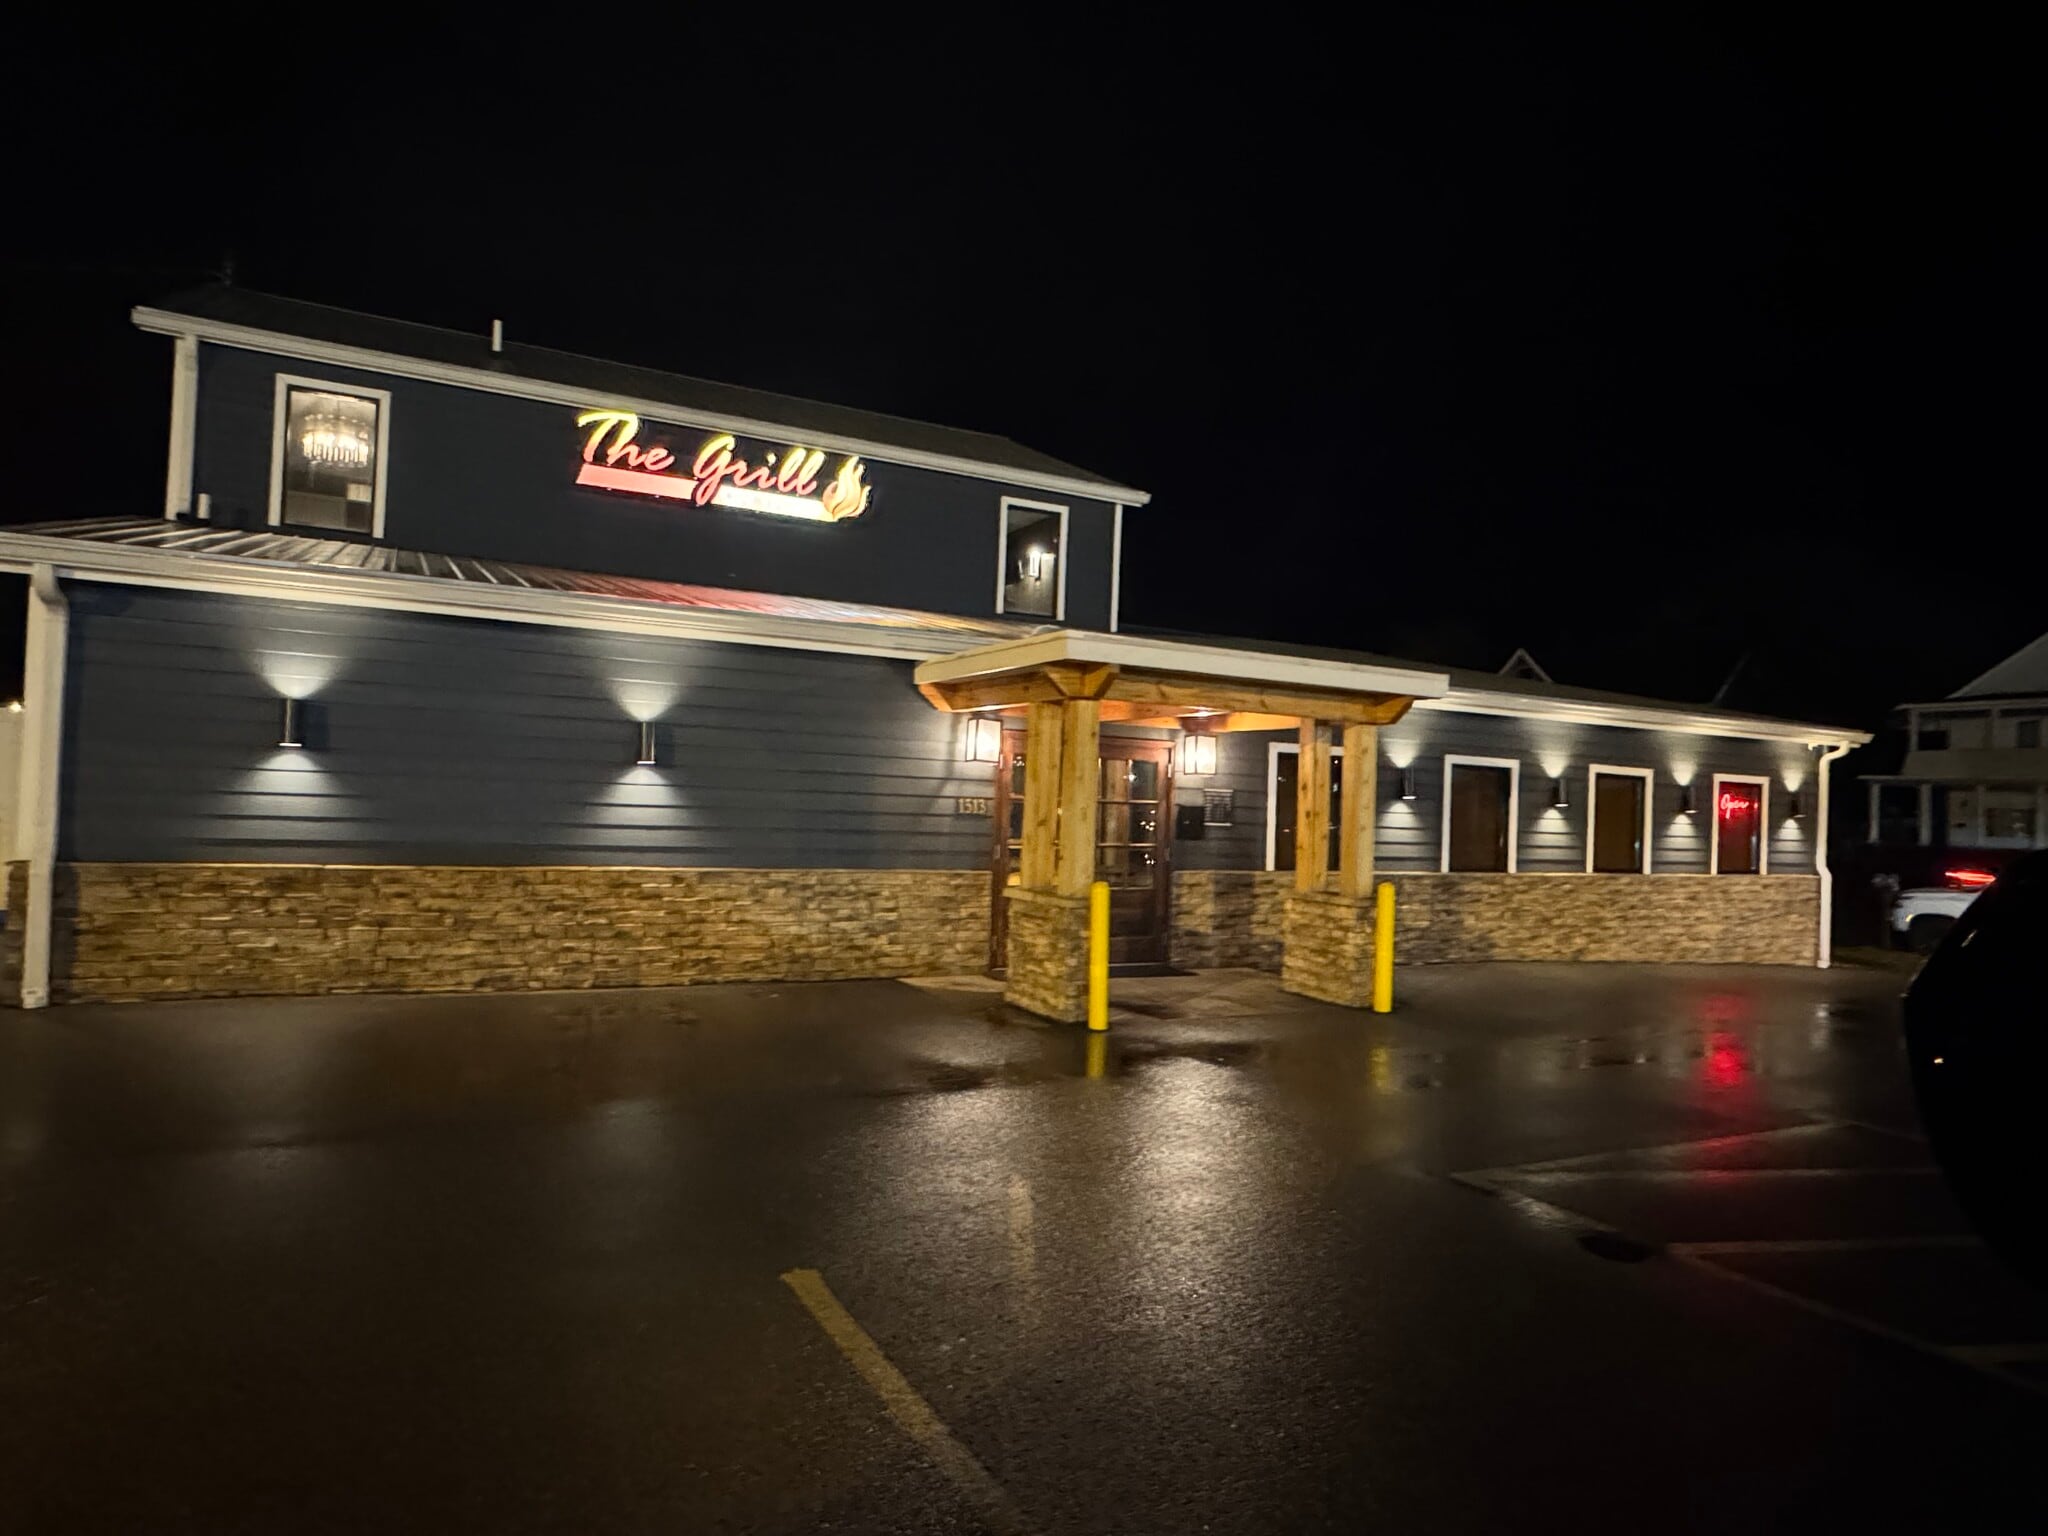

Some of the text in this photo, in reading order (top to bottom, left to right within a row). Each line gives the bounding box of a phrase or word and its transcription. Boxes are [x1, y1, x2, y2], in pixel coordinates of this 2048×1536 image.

[577, 410, 826, 506] The Grill
[958, 798, 987, 815] 1513
[1720, 793, 1750, 819] Open
